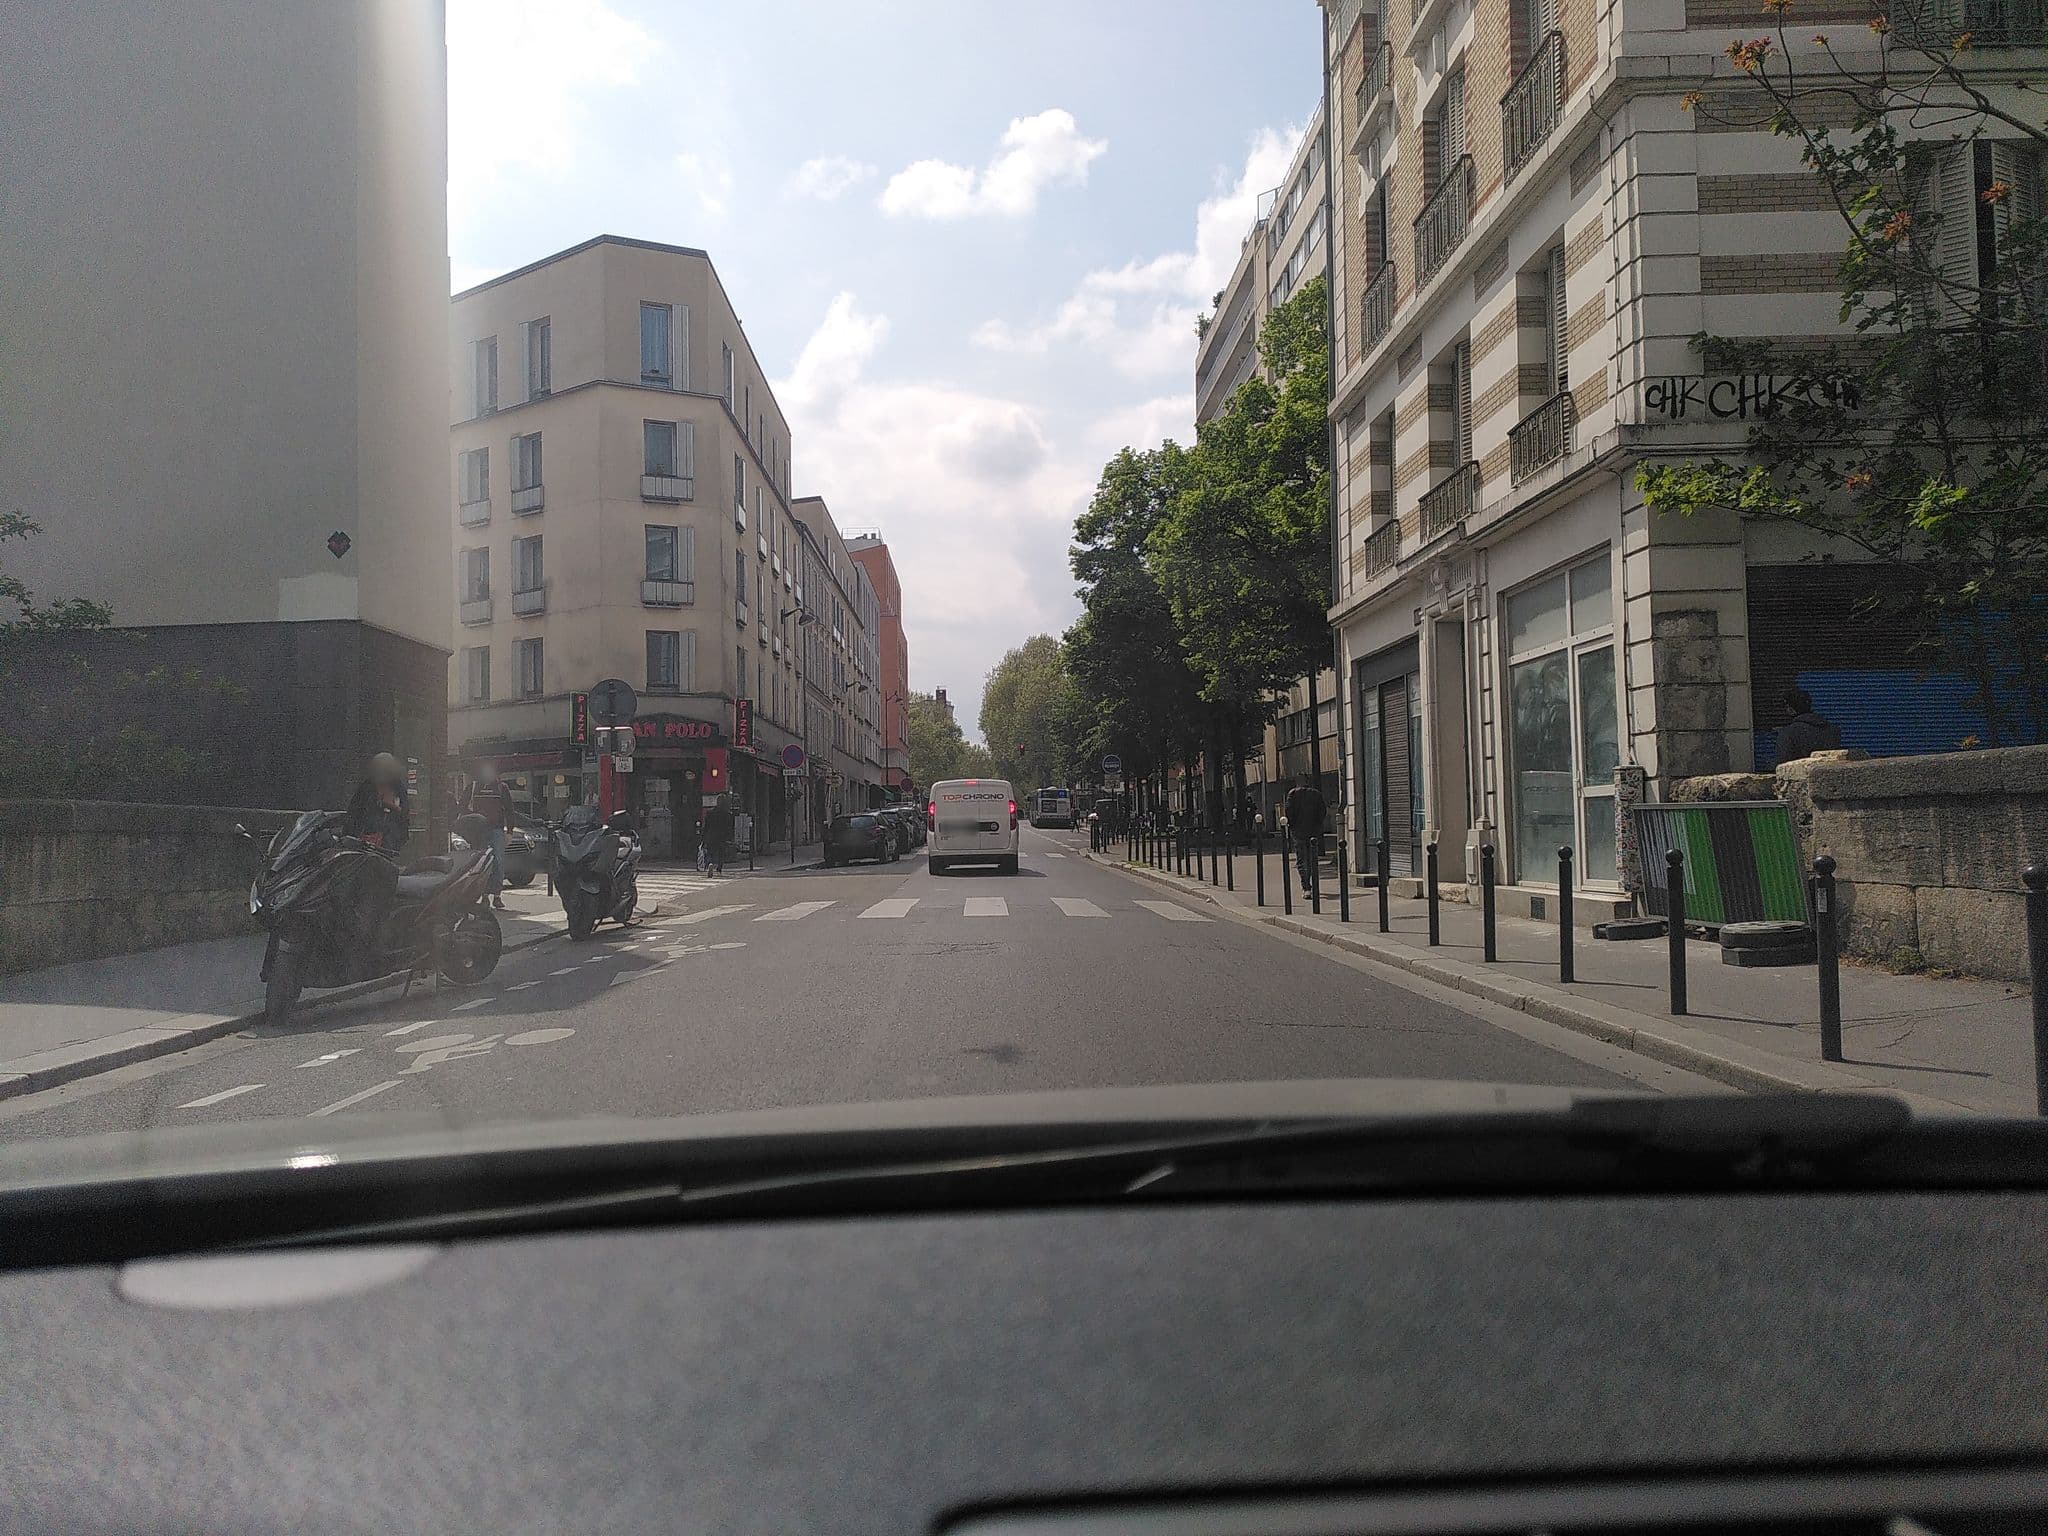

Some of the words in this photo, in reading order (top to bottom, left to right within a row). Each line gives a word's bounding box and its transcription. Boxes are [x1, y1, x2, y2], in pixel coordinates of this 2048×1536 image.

[576, 694, 585, 742] PIZZA
[664, 723, 712, 737] POLO
[738, 701, 747, 746] PIZZA
